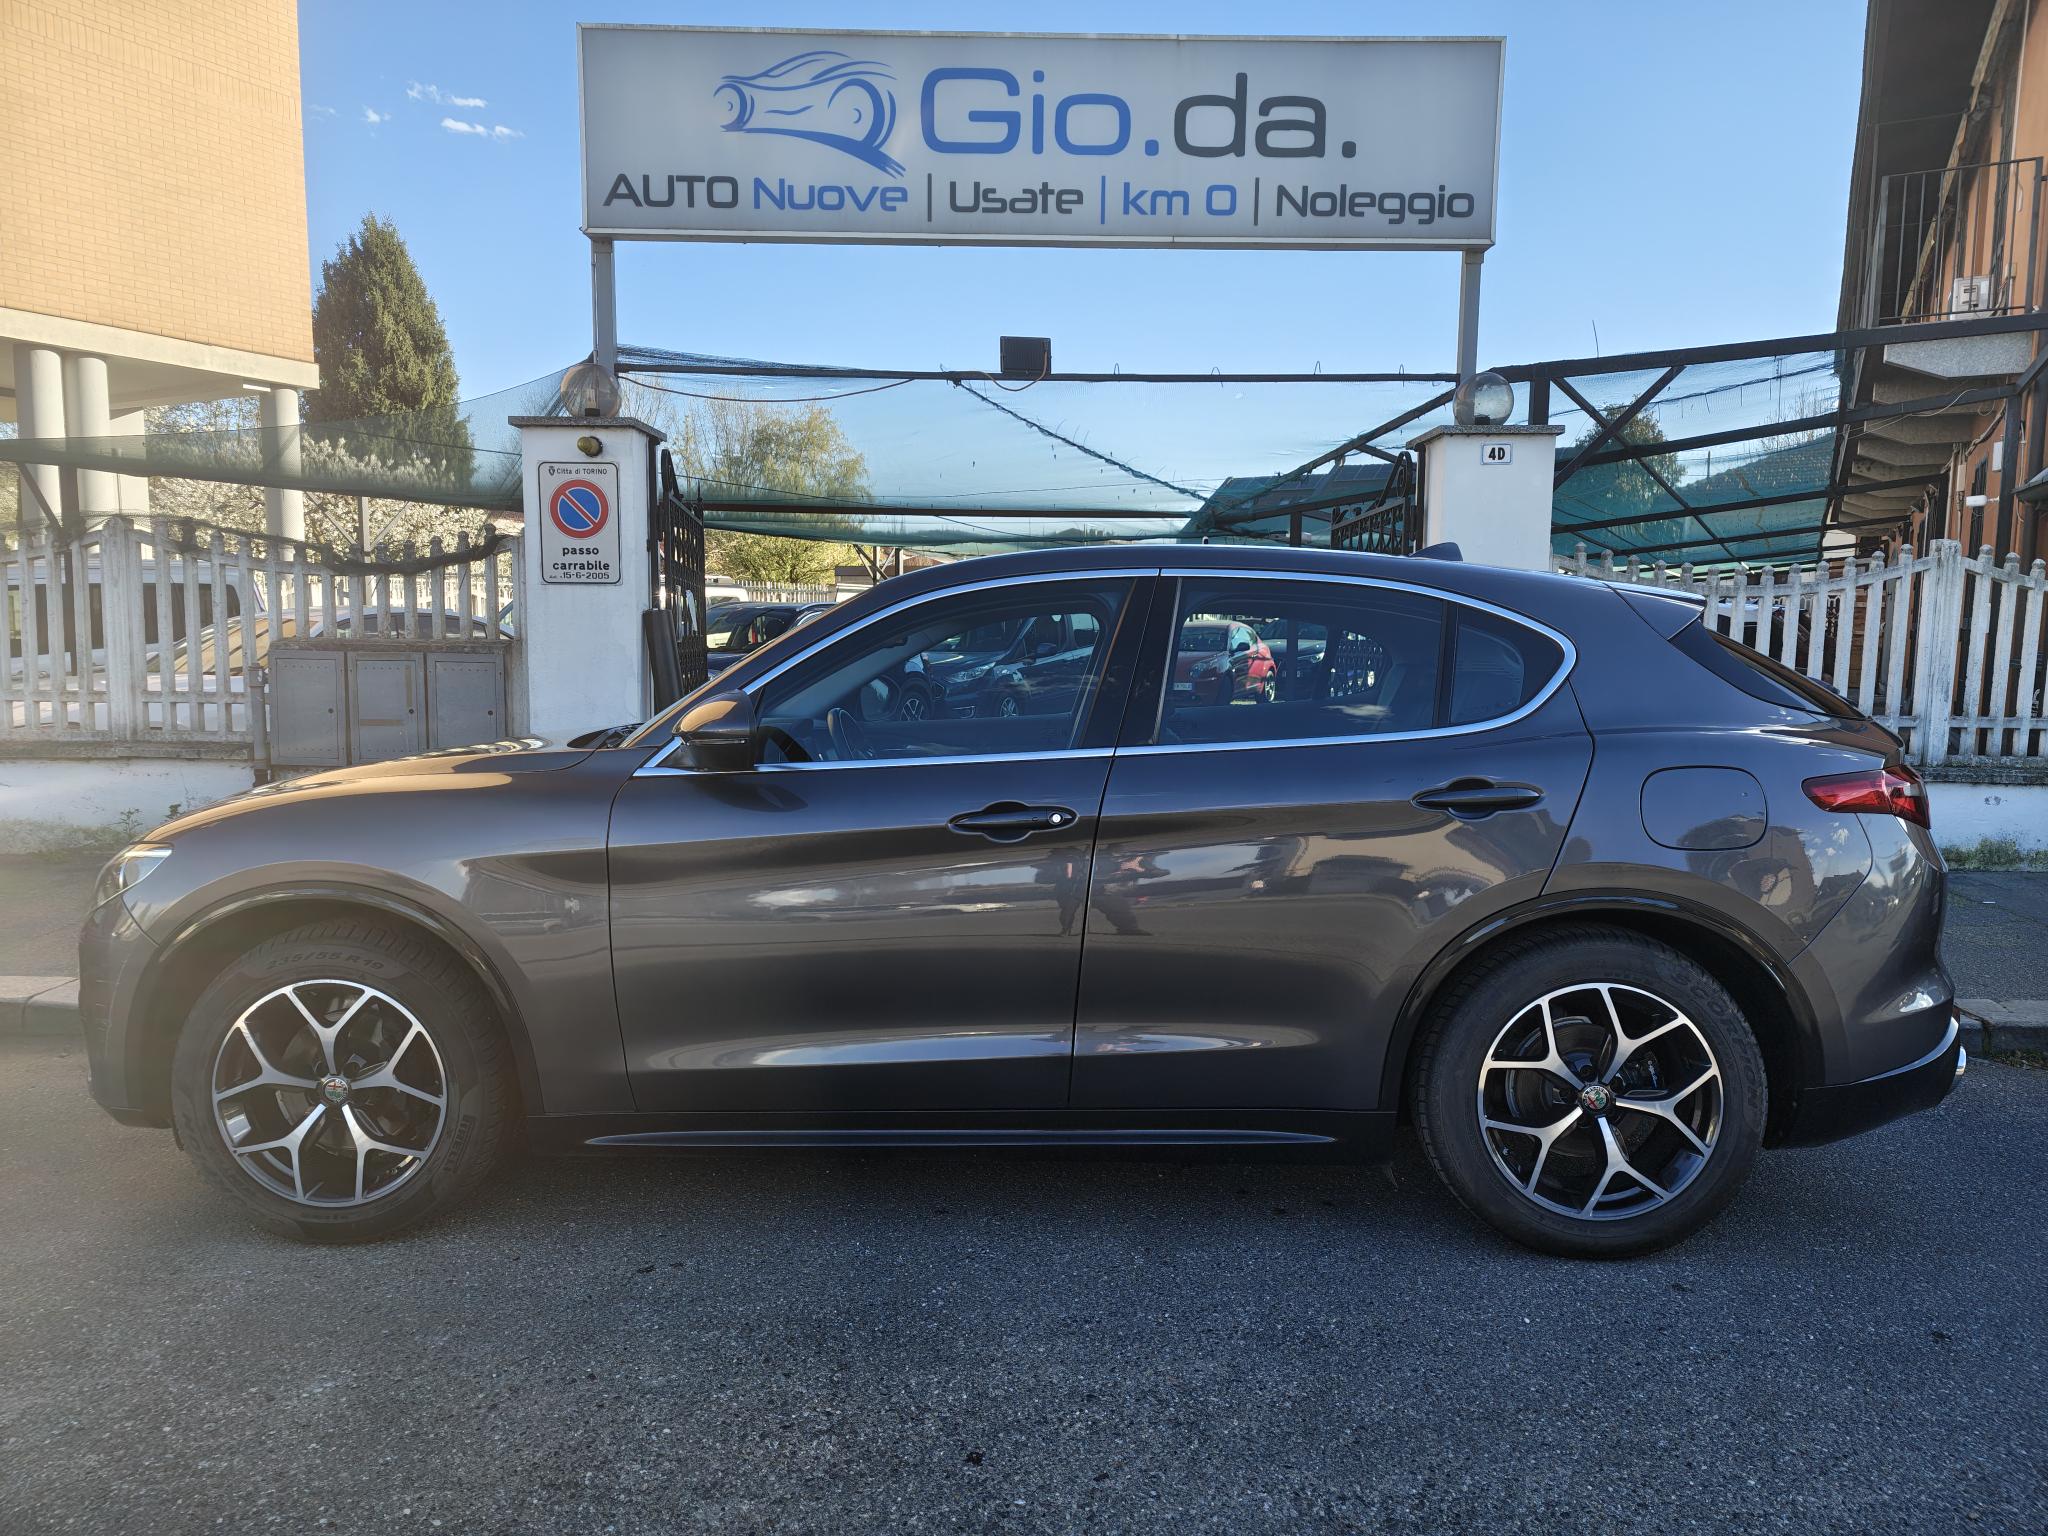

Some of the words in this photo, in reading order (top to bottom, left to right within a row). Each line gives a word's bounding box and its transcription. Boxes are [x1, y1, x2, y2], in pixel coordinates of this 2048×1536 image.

[921, 68, 1356, 158] Gio.da.
[603, 174, 738, 208] AUTO
[753, 177, 908, 212] Nuove
[950, 181, 1083, 214] Usate
[1123, 182, 1189, 215] km
[1277, 184, 1476, 226] Noleggio
[1488, 447, 1506, 461] 4D
[562, 547, 600, 557] passo
[553, 560, 610, 570] carrabile
